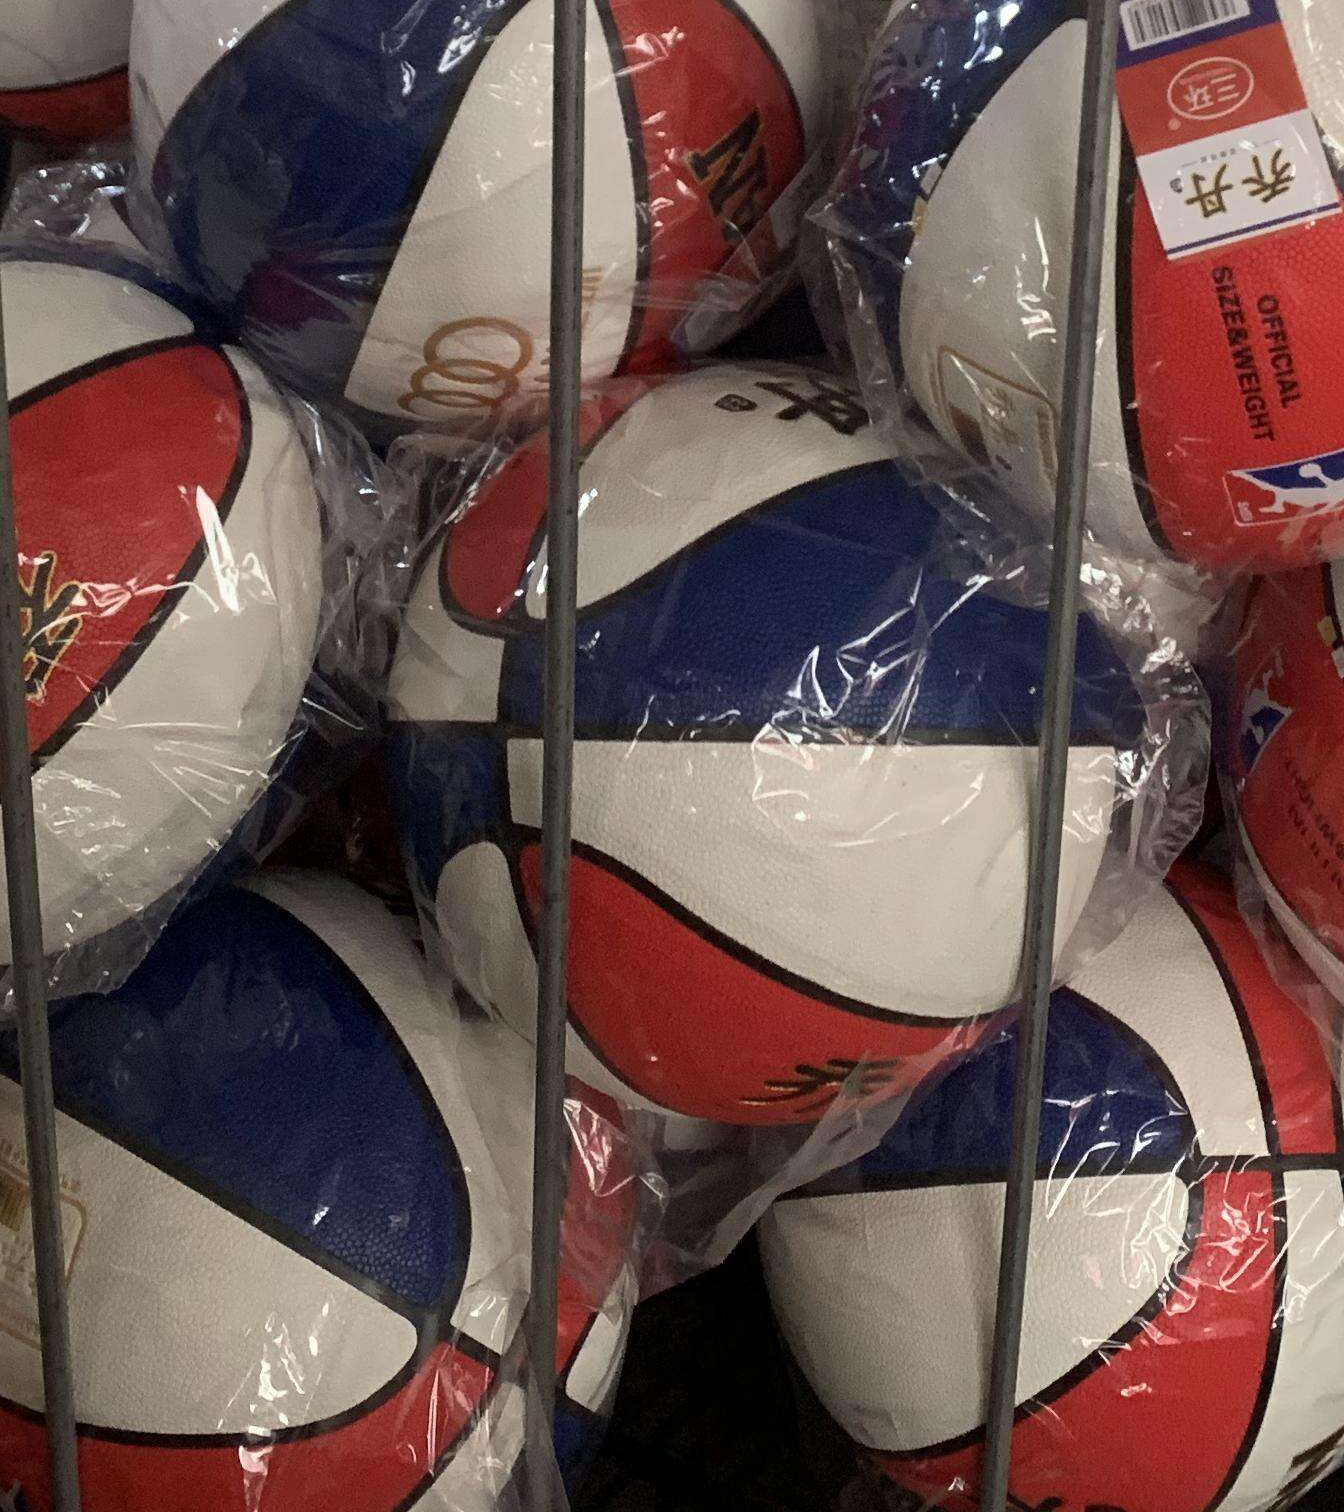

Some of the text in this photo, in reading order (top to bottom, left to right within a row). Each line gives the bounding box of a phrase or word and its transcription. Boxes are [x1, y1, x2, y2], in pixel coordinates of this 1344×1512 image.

[1177, 66, 1245, 113] 三环
[1185, 144, 1297, 219] 乔丹
[1211, 265, 1277, 443] SIZE&WEIGHT
[1256, 293, 1303, 410] OFFICIAL
